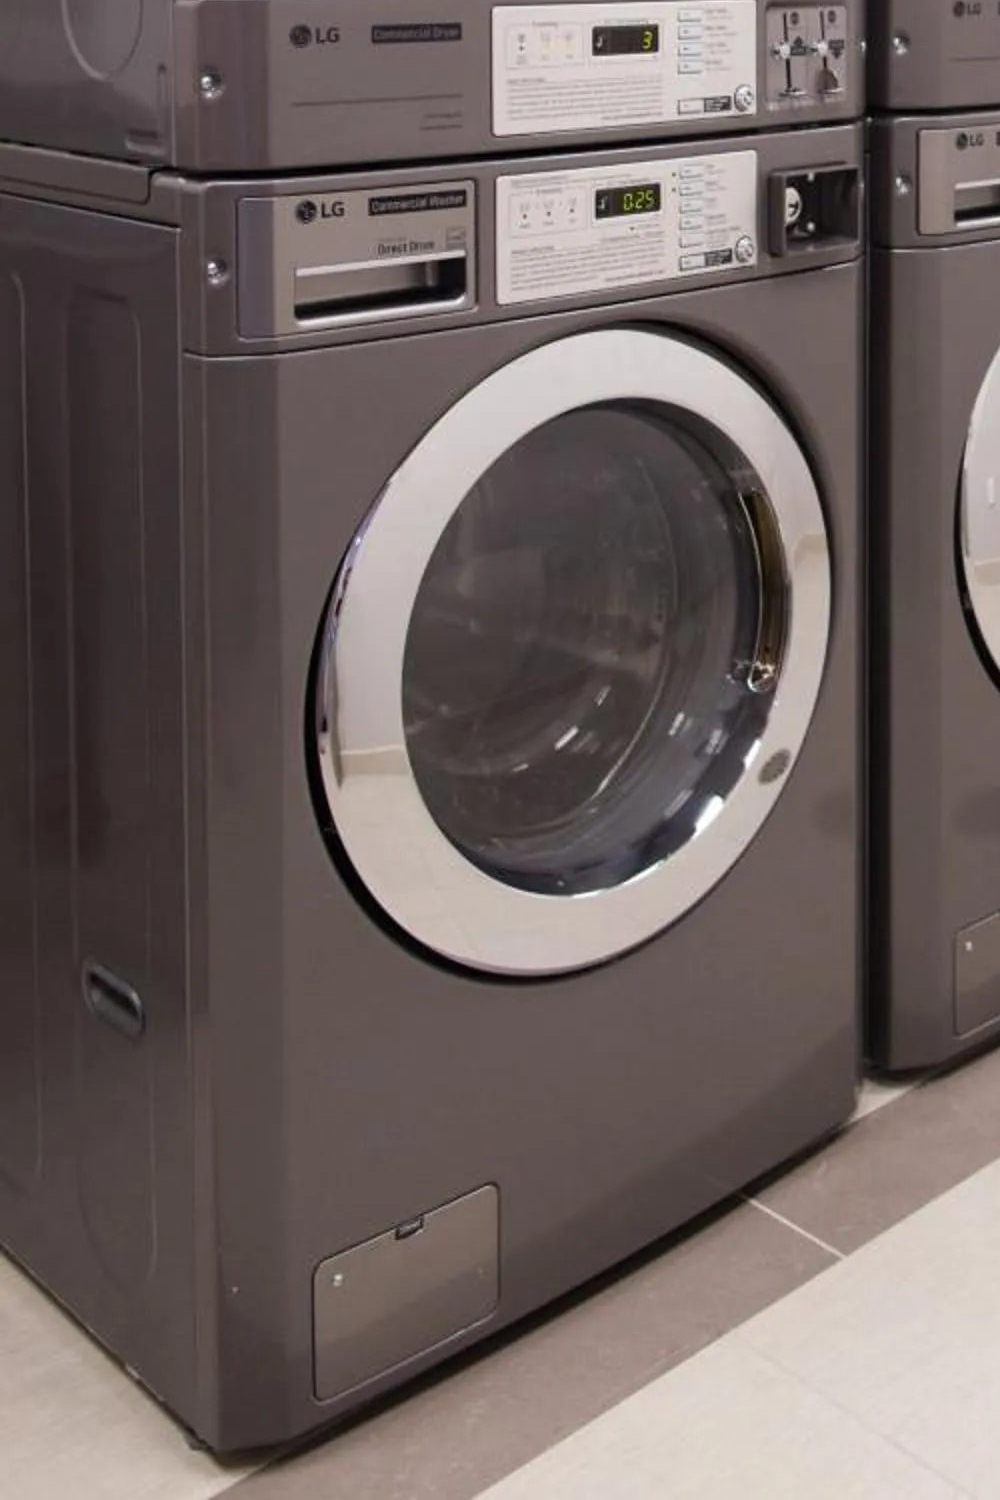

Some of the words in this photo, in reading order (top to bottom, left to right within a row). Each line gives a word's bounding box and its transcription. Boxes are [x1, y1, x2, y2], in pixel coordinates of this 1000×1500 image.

[966, 2, 981, 16] LG
[315, 26, 341, 44] LG
[641, 30, 653, 50] 3
[320, 200, 345, 219] LG
